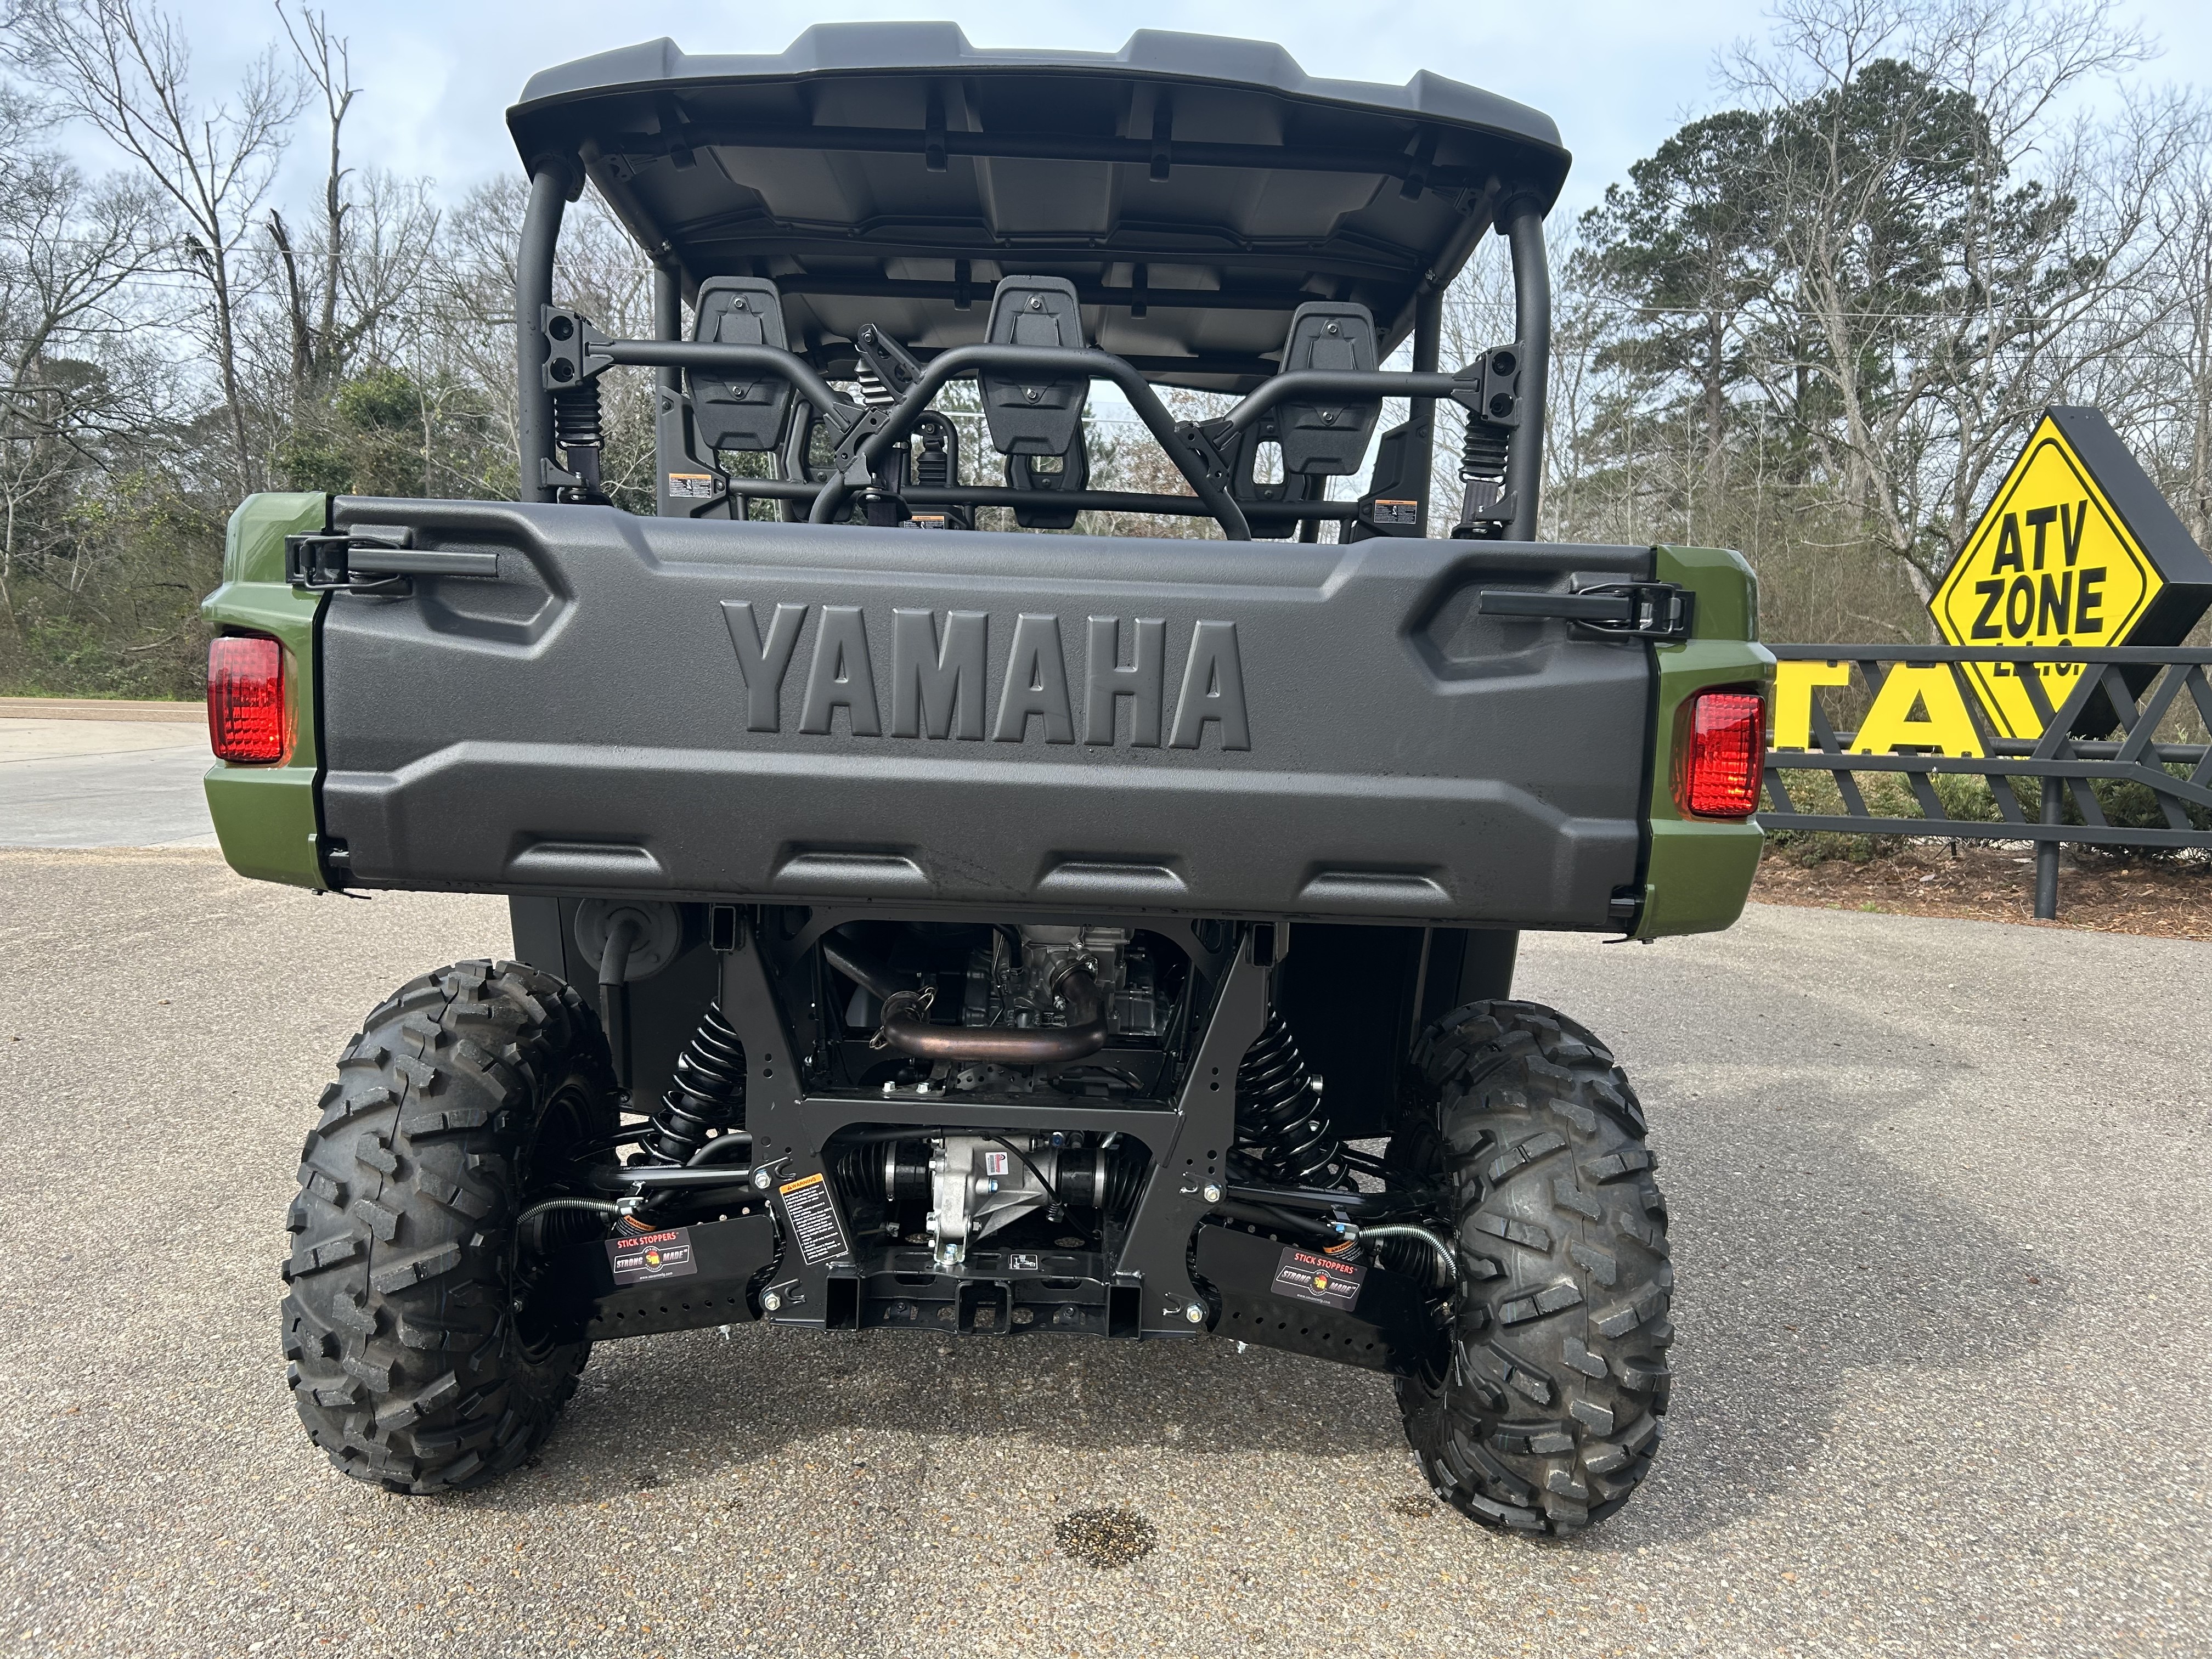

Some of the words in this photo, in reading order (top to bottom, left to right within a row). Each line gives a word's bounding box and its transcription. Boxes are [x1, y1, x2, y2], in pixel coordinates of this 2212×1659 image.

[1991, 499, 2088, 575] ATV
[1971, 567, 2107, 640] ZONE
[720, 600, 1251, 751] YAMAHA
[792, 1177, 816, 1189] WARNING
[617, 1238, 639, 1249] STICK
[640, 1232, 676, 1245] STOPPERS
[616, 1257, 644, 1268] STRONG
[1294, 1252, 1317, 1266] STICK
[1317, 1257, 1354, 1274] STOPPERS
[1282, 1270, 1311, 1283] STRONG
